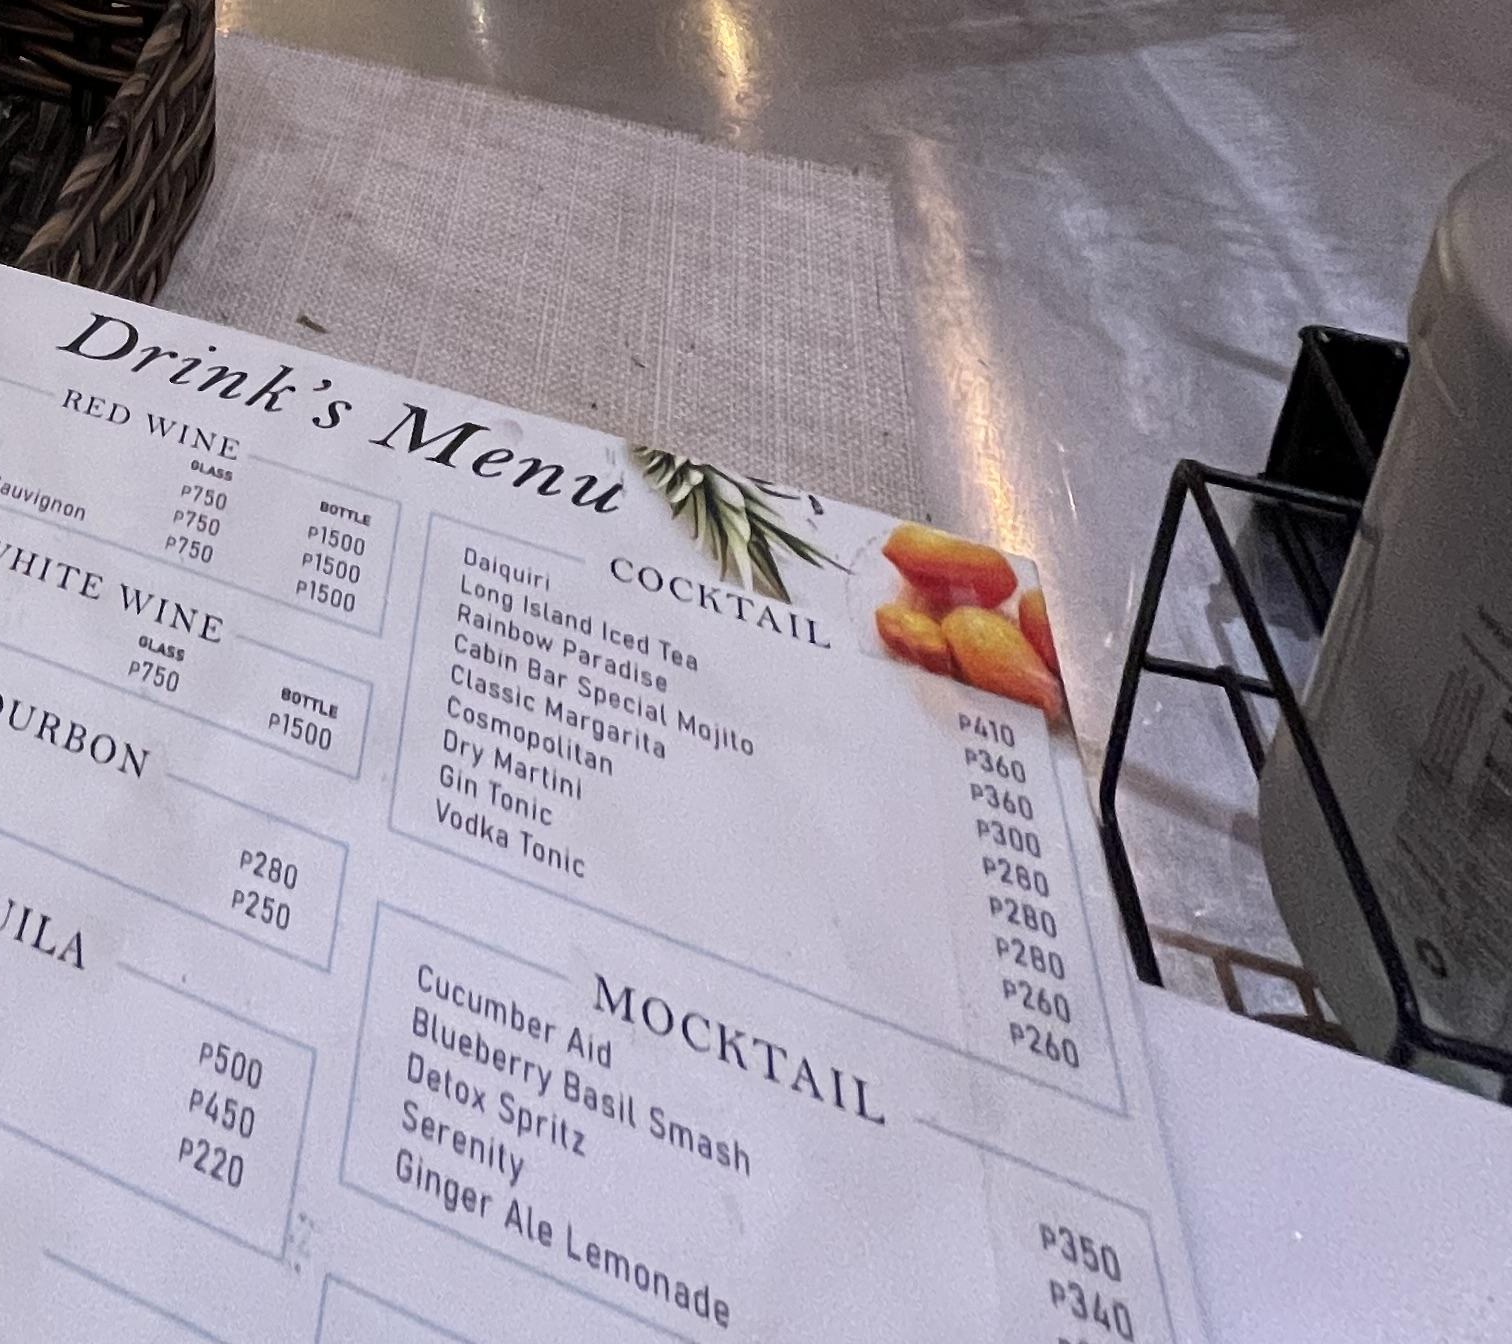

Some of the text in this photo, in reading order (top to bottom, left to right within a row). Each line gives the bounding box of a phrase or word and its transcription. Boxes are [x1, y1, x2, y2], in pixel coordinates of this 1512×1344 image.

[55, 311, 626, 515] Drink's Menu
[61, 388, 241, 461] RED WINE
[190, 459, 233, 482] GLASS
[180, 484, 228, 512] P750
[319, 500, 372, 528] BOTTLE
[172, 509, 221, 537] P750
[307, 525, 366, 557] P1500
[164, 534, 214, 564] P750
[301, 552, 361, 585] P1500
[463, 546, 550, 592] Daiquiri
[119, 582, 224, 645] WINE
[295, 579, 356, 613] P1500
[609, 556, 832, 650] COCKTAIL
[460, 573, 699, 673] Long Island Iced Tea
[137, 634, 186, 663] GLASS
[456, 602, 668, 694] Rainbow Paradise
[127, 660, 180, 693] P750
[453, 632, 755, 757] Cabin Bar Special Mojito
[280, 686, 339, 720] BOTTLE
[450, 663, 666, 760] Classic Margarita
[267, 711, 333, 752] P1500
[446, 694, 613, 777] Cosmopolitan
[958, 713, 1016, 749] P410
[442, 727, 582, 801] Dry Martini
[964, 747, 1027, 784] P360
[439, 763, 553, 827] Gin Tonic
[969, 782, 1034, 821] P360
[435, 797, 585, 879] Vodka Tonic
[975, 818, 1042, 859] P300
[239, 849, 299, 891] P280
[981, 855, 1050, 898] P280
[231, 888, 291, 931] P250
[988, 895, 1058, 940] P280
[995, 936, 1066, 981] P280
[417, 963, 612, 1070] Cucumber Aid
[1001, 978, 1072, 1025] P260
[198, 1041, 264, 1091] P500
[592, 972, 887, 1127] MOCKTAIL
[1008, 1021, 1081, 1070] P260
[188, 1087, 256, 1140] P450
[406, 1050, 586, 1158] Detox Spritz
[412, 1005, 751, 1177] Blueberry Basil Smash
[178, 1136, 245, 1189] P220
[401, 1098, 525, 1189] Serenity
[395, 1147, 730, 1330] Ginger Ale Lemonade
[1039, 1223, 1122, 1283] P350
[1049, 1278, 1134, 1343] P340
